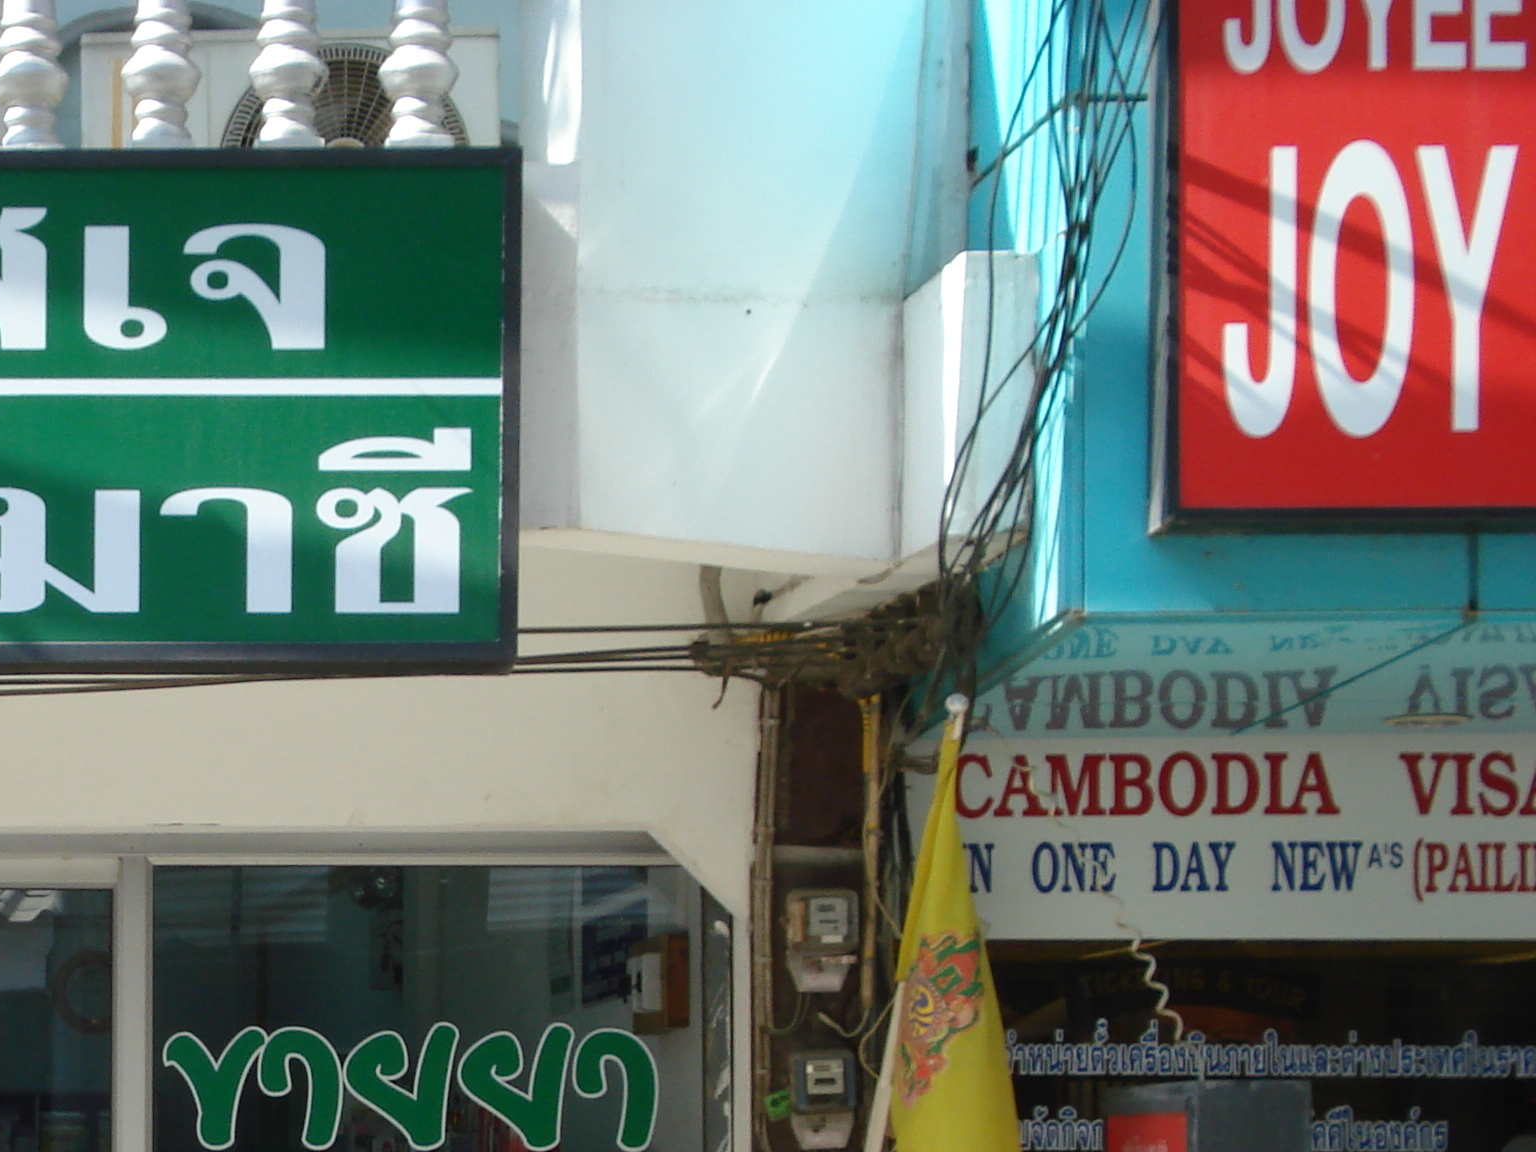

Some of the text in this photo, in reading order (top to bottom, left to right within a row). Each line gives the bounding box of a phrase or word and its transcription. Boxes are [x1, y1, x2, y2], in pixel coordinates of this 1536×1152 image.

[1223, 139, 1518, 437] JOY
[954, 752, 1536, 818] CAMBODIA VIS
[1031, 841, 1117, 894] ONE
[1152, 841, 1236, 893] DAY
[1271, 841, 1363, 893] NEW
[1414, 837, 1536, 901] (PAILI
[163, 1021, 659, 1152] ขายยา
